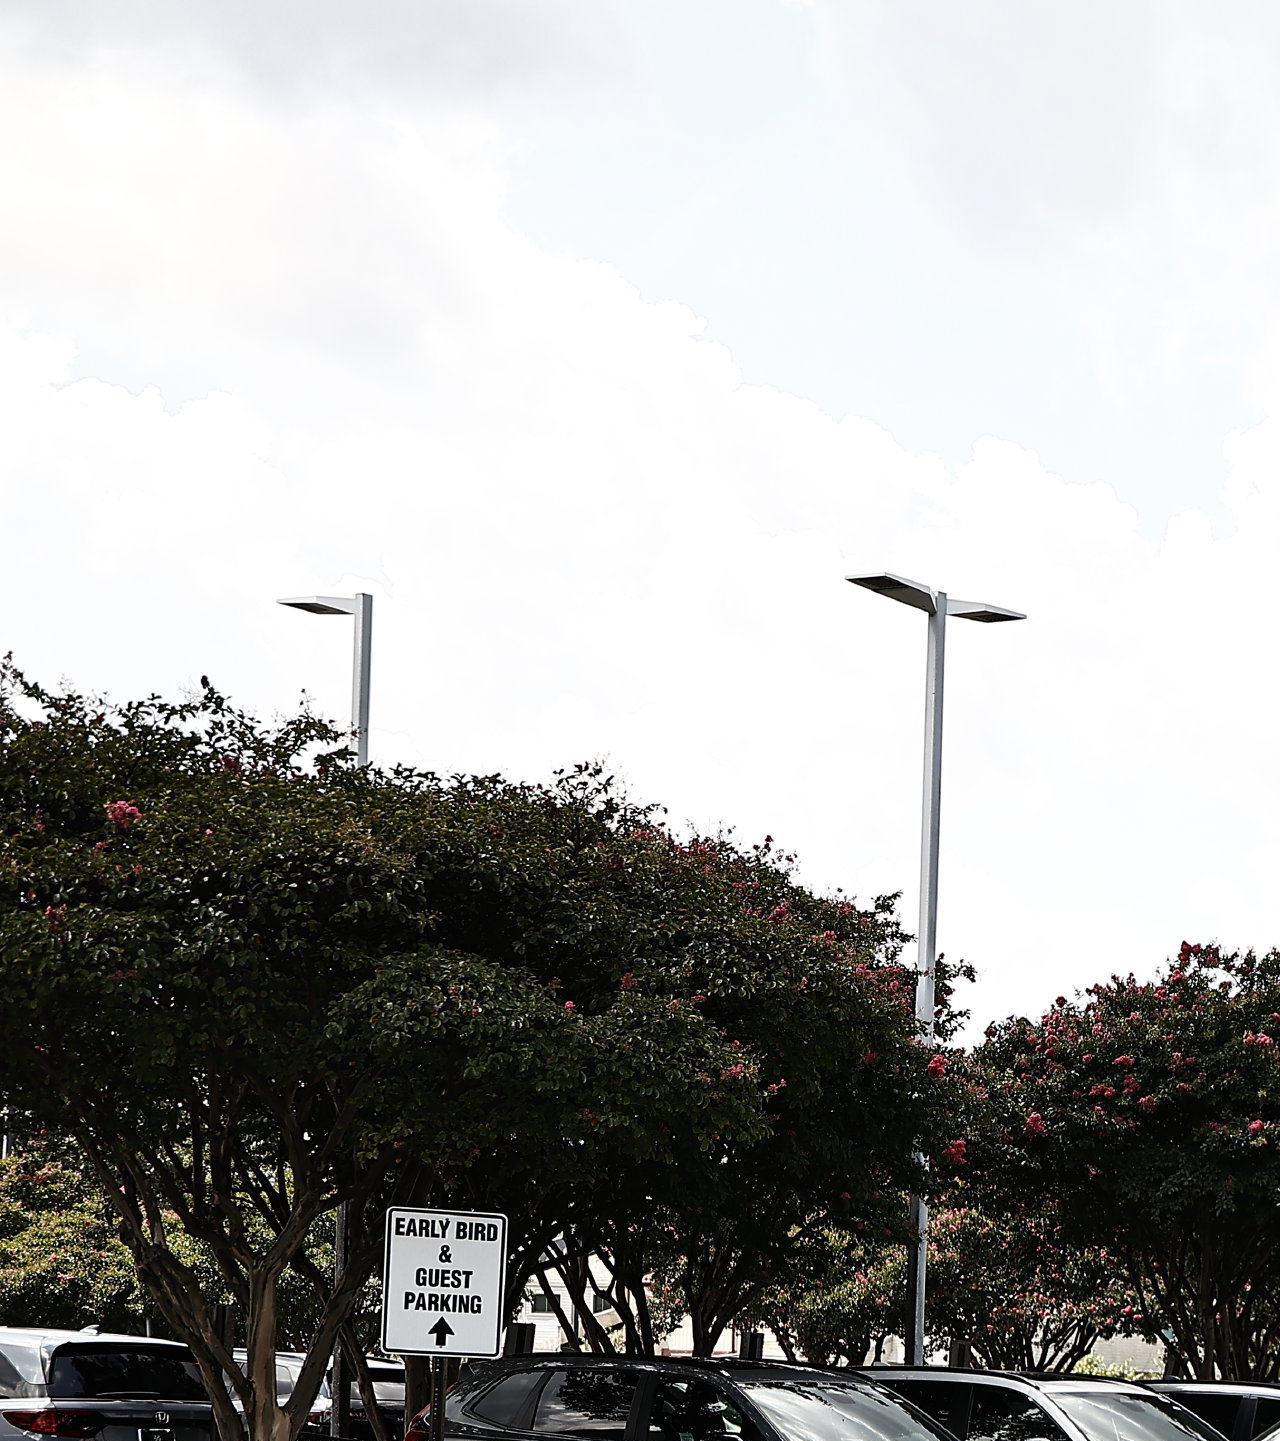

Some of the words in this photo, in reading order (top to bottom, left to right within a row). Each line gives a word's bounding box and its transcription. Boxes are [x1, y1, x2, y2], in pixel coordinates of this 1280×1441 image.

[394, 1217, 450, 1239] EARLY
[455, 1221, 498, 1242] BIRD
[438, 1245, 452, 1263] &
[415, 1267, 473, 1289] GUEST
[403, 1291, 482, 1314] PARKING
